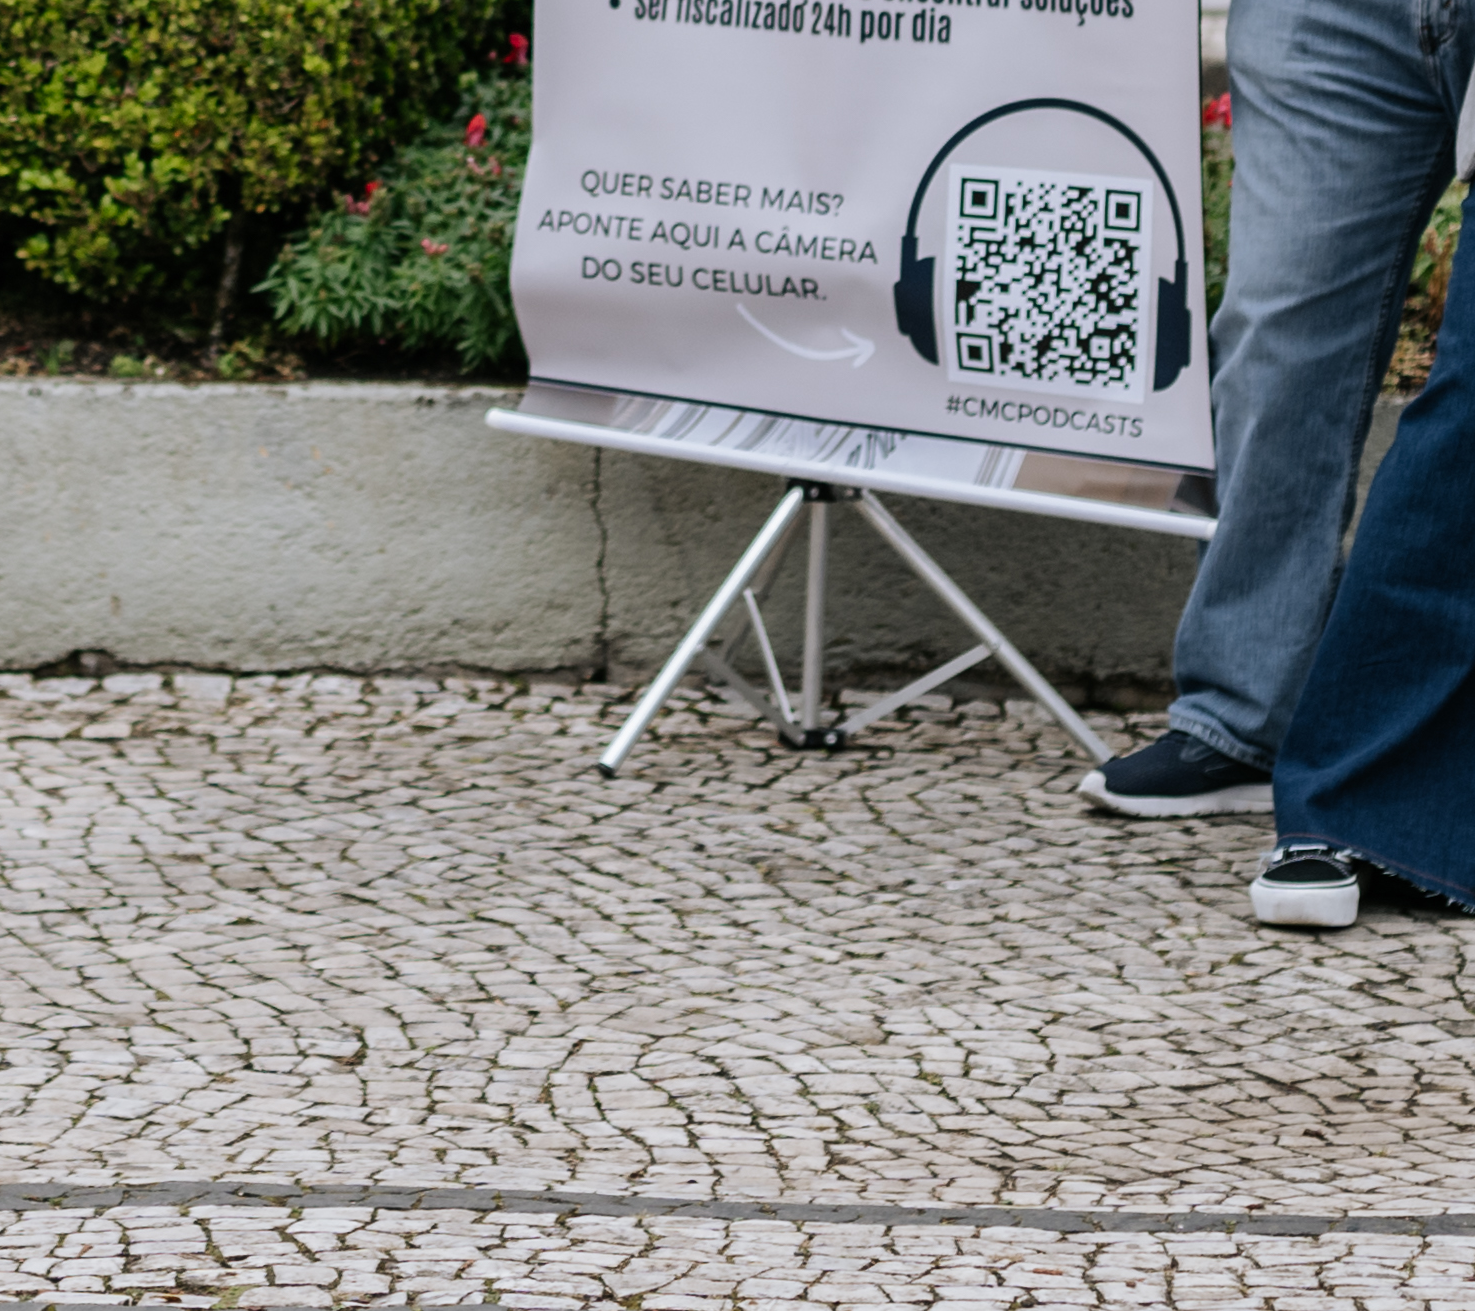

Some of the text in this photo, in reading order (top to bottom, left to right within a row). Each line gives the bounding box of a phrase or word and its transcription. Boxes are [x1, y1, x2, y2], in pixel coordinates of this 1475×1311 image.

[860, 10, 905, 44] por
[912, 7, 951, 44] dia
[581, 169, 844, 216] QUER SABER MAIS?
[538, 209, 878, 264] APONTE AQUI A CÂMERA
[582, 256, 827, 301] DO SEU CELULAR.
[946, 395, 1143, 438] #CMCPODCASTS
